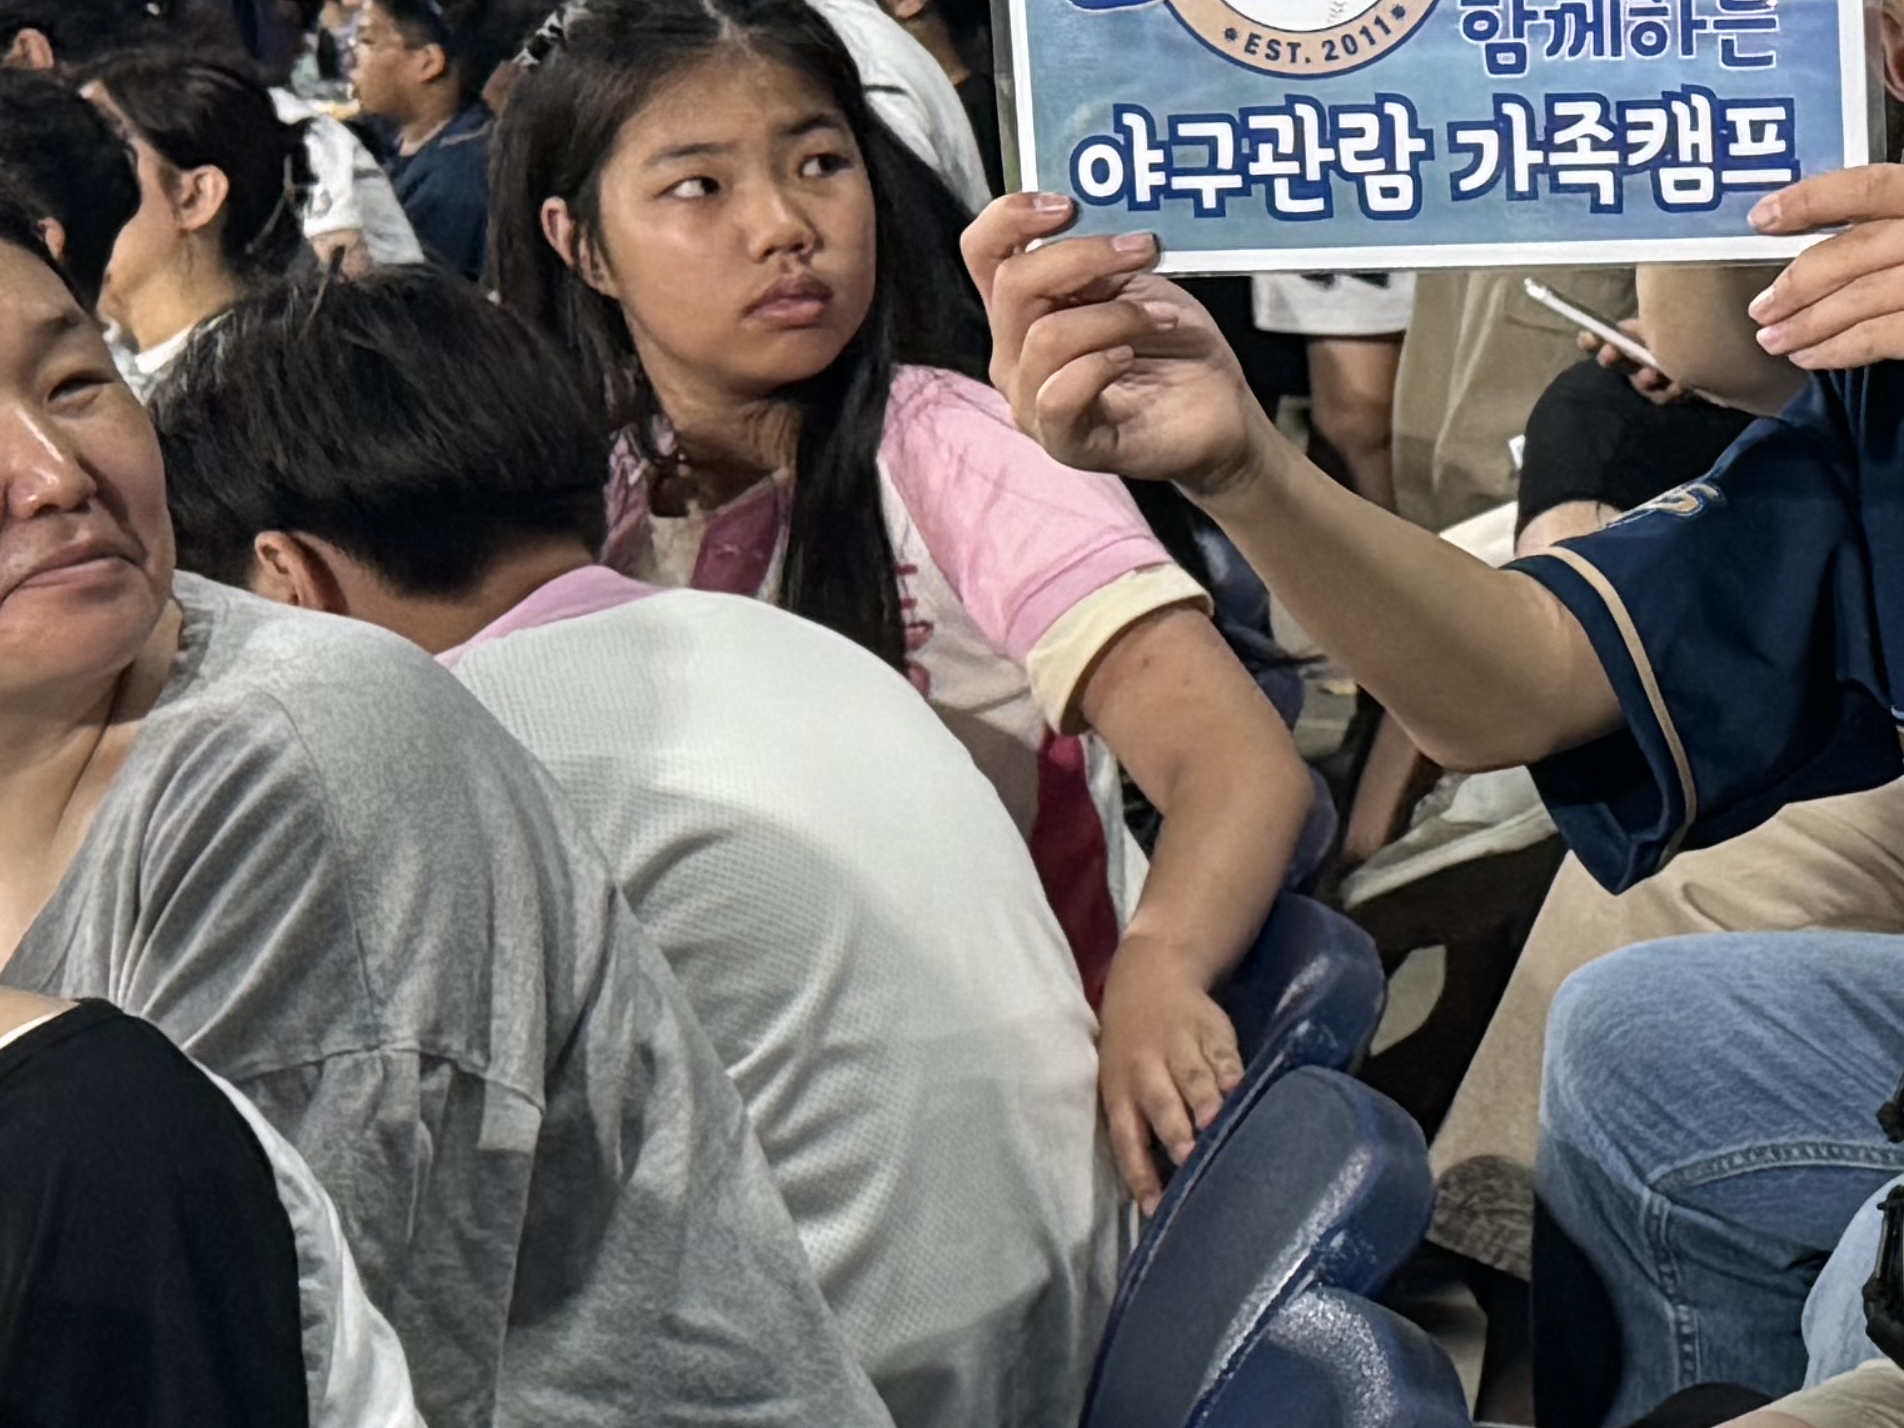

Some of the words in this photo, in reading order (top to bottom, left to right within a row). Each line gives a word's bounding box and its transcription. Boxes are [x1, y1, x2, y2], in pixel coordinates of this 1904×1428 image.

[1244, 32, 1312, 64] EST.
[1321, 14, 1391, 62] 2011
[1073, 97, 1428, 220] 야구관람
[1449, 86, 1798, 213] 가족캠프
